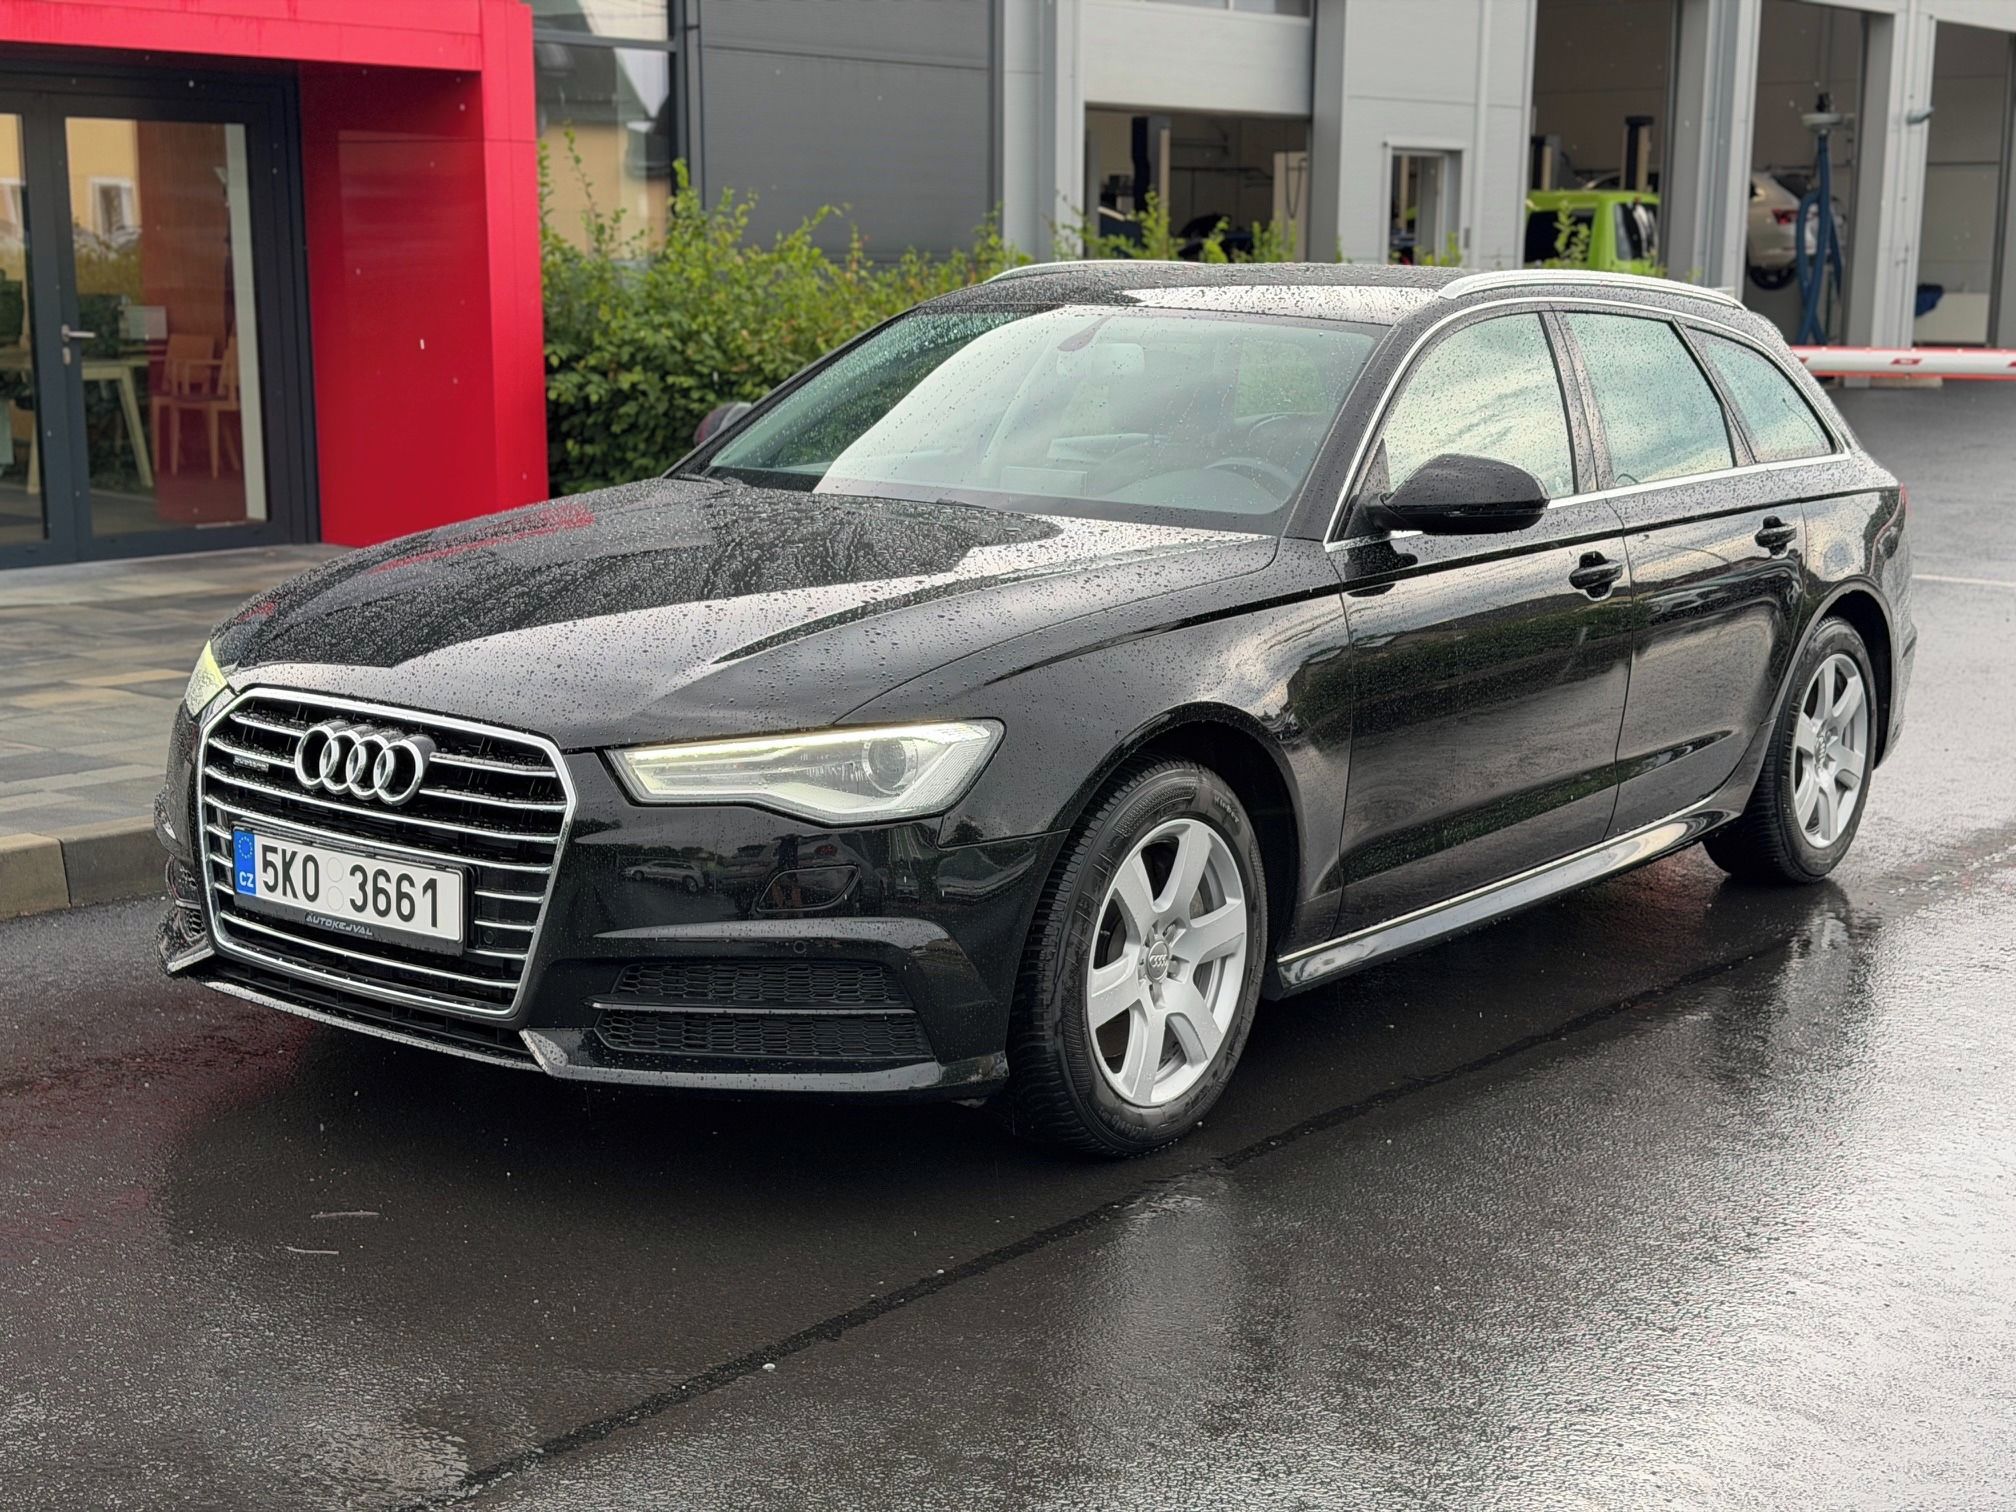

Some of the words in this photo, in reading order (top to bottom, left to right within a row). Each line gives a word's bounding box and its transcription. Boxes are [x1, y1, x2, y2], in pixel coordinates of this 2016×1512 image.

[239, 870, 254, 888] CZ
[261, 843, 320, 902] 5K0
[349, 864, 438, 929] 3661
[305, 913, 373, 937] AUTOKEJVAL
